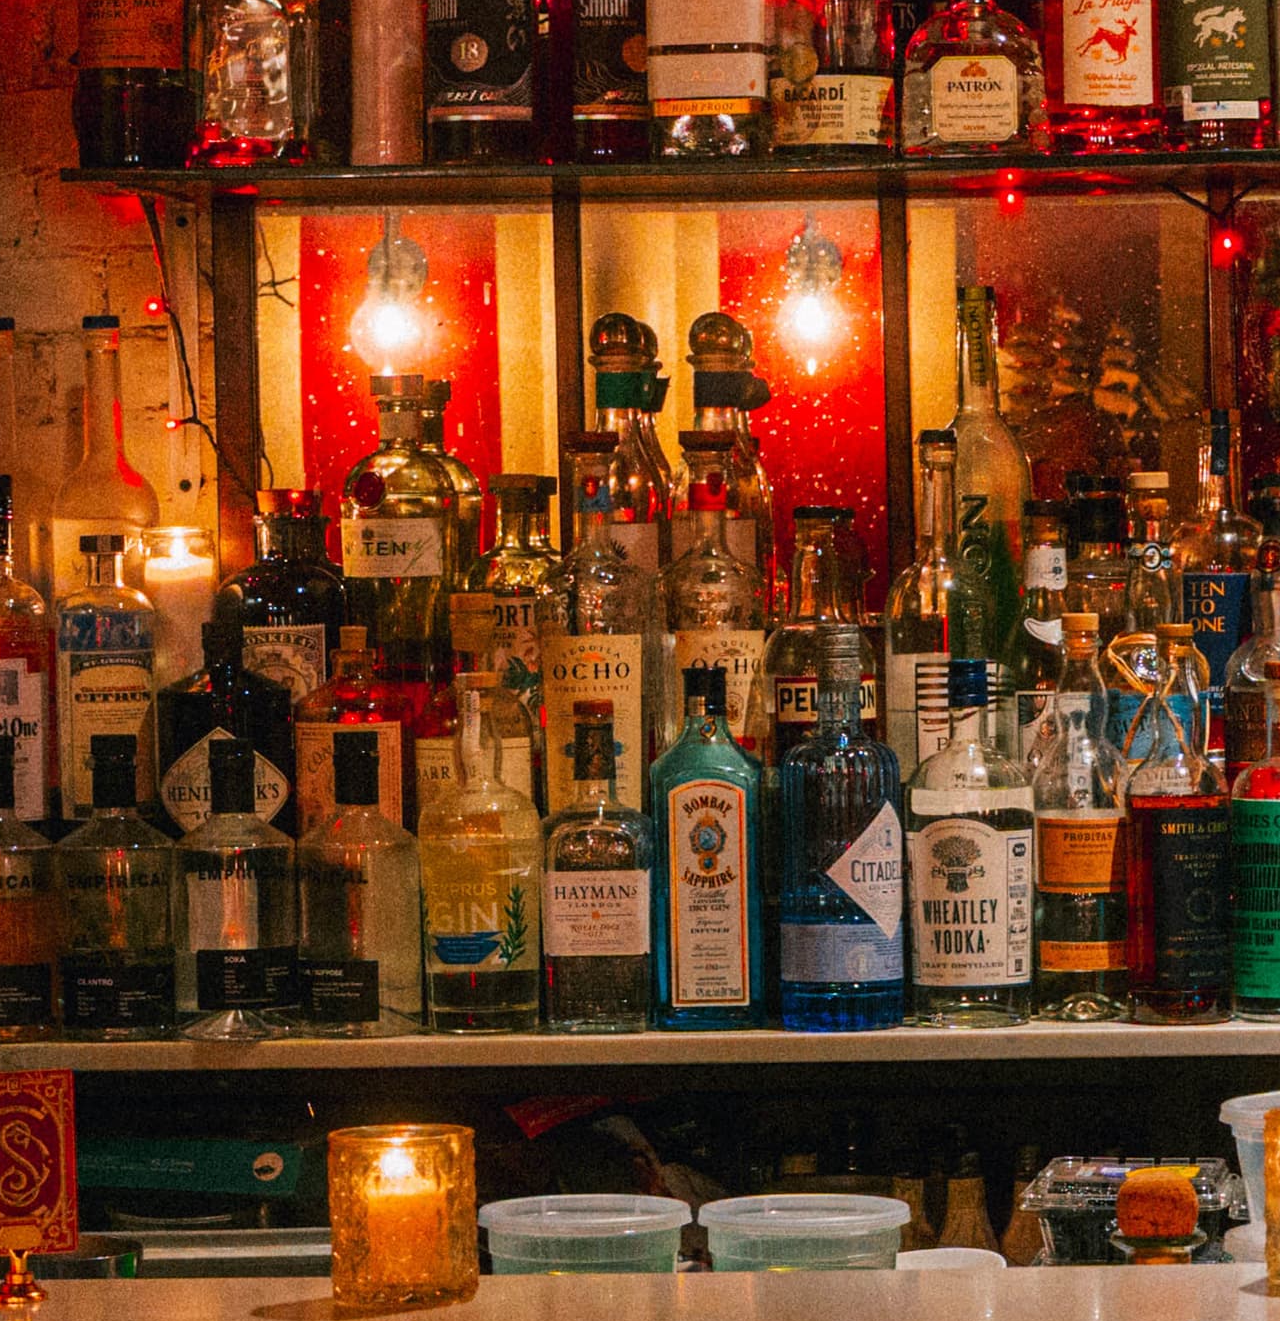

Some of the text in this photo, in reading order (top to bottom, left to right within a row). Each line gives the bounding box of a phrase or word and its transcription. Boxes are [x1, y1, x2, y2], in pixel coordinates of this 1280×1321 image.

[458, 41, 479, 59] 18
[783, 82, 845, 102] BACARDÍ
[947, 77, 1002, 92] PATRÓN
[671, 102, 735, 114] HIGH PROOF
[363, 542, 406, 555] TEN
[1190, 581, 1225, 597] TEN
[1189, 599, 1216, 614] TO
[1189, 617, 1225, 632] ONE
[553, 662, 631, 680] OCHO
[10, 717, 38, 737] One
[167, 783, 279, 802] HENK'S
[682, 795, 733, 818] BOMBAY
[1063, 832, 1113, 842] PROBITAS
[1161, 823, 1194, 835] SMITH
[681, 866, 738, 889] SAPPHIRE
[431, 902, 498, 933] GIN
[922, 898, 998, 924] WHEATLEY
[935, 929, 985, 955] VODKA
